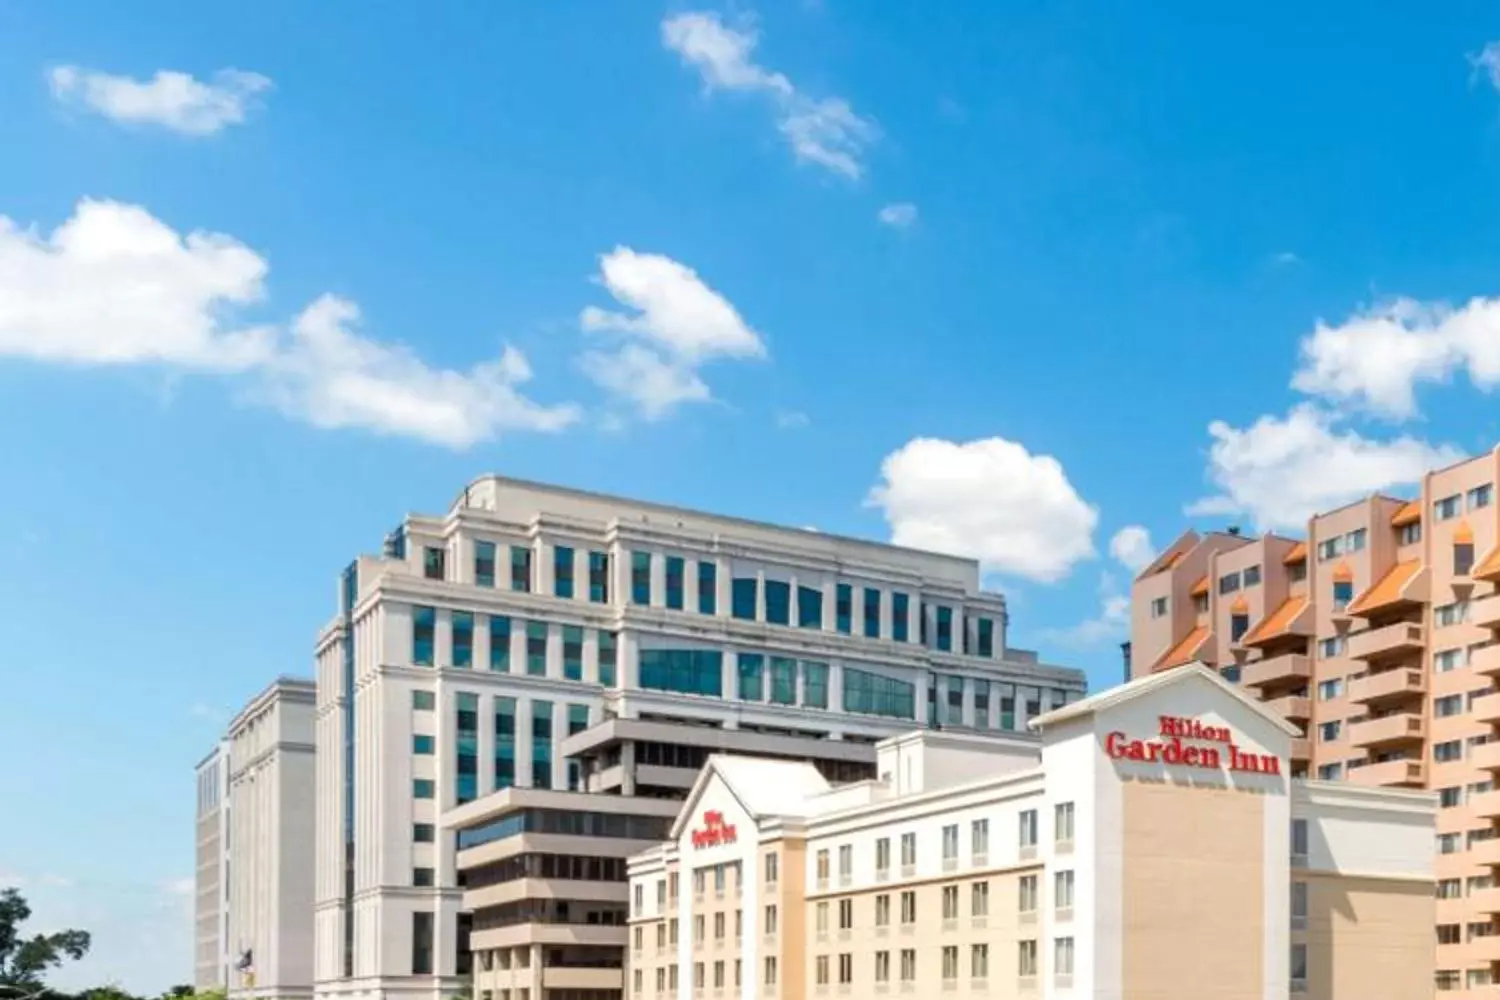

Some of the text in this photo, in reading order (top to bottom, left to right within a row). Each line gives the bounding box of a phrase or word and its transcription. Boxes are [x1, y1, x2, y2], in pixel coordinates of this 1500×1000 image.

[1159, 716, 1231, 742] Hilton
[1105, 731, 1280, 775] Garden Inn
